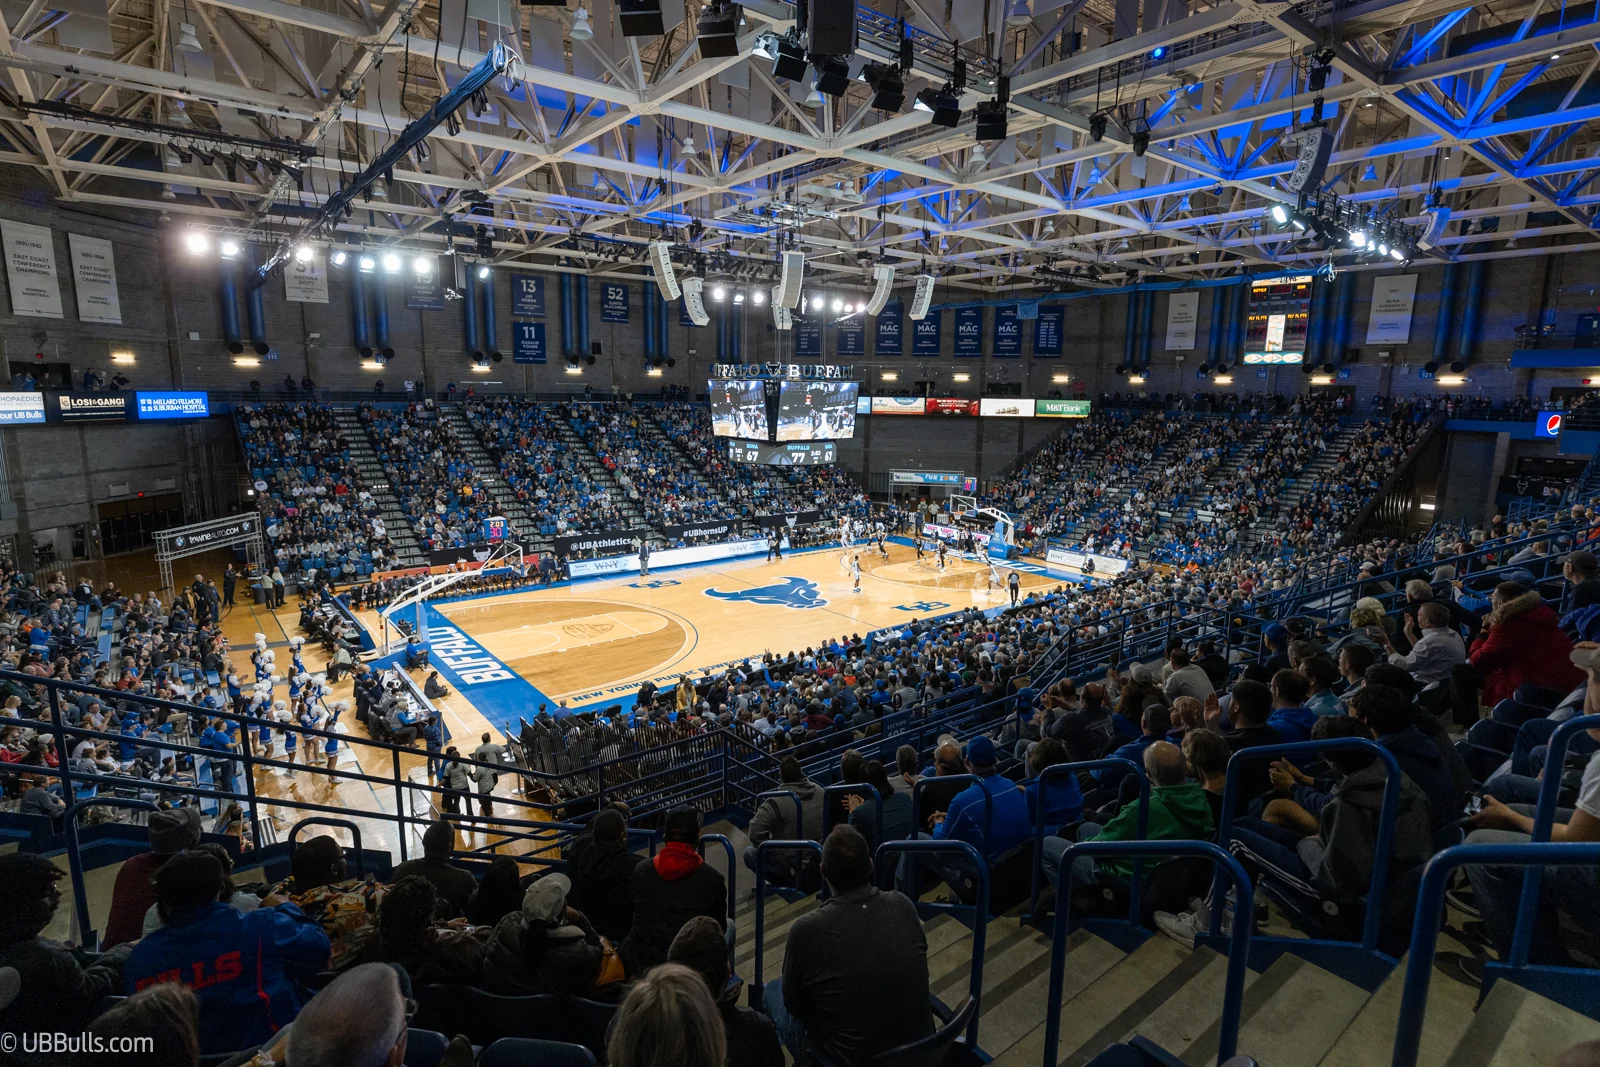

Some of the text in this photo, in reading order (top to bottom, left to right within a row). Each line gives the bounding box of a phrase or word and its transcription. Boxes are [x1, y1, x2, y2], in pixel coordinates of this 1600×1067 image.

[13, 260, 51, 270] CONFERENCE
[16, 267, 50, 276] CHAMPIONS
[79, 271, 112, 279] CONFERENCE
[520, 280, 537, 293] 13
[608, 287, 624, 300] 52
[522, 326, 536, 340] 11
[746, 451, 758, 462] 67
[792, 452, 806, 463] 77
[824, 451, 832, 462] 67
[683, 526, 728, 538] #UBhornsUP
[570, 537, 632, 550] @UBAthletics
[594, 560, 620, 570] WNY
[428, 626, 516, 685] BUFFALO
[572, 690, 604, 702] NEW
[654, 670, 698, 682] PUBLIC
